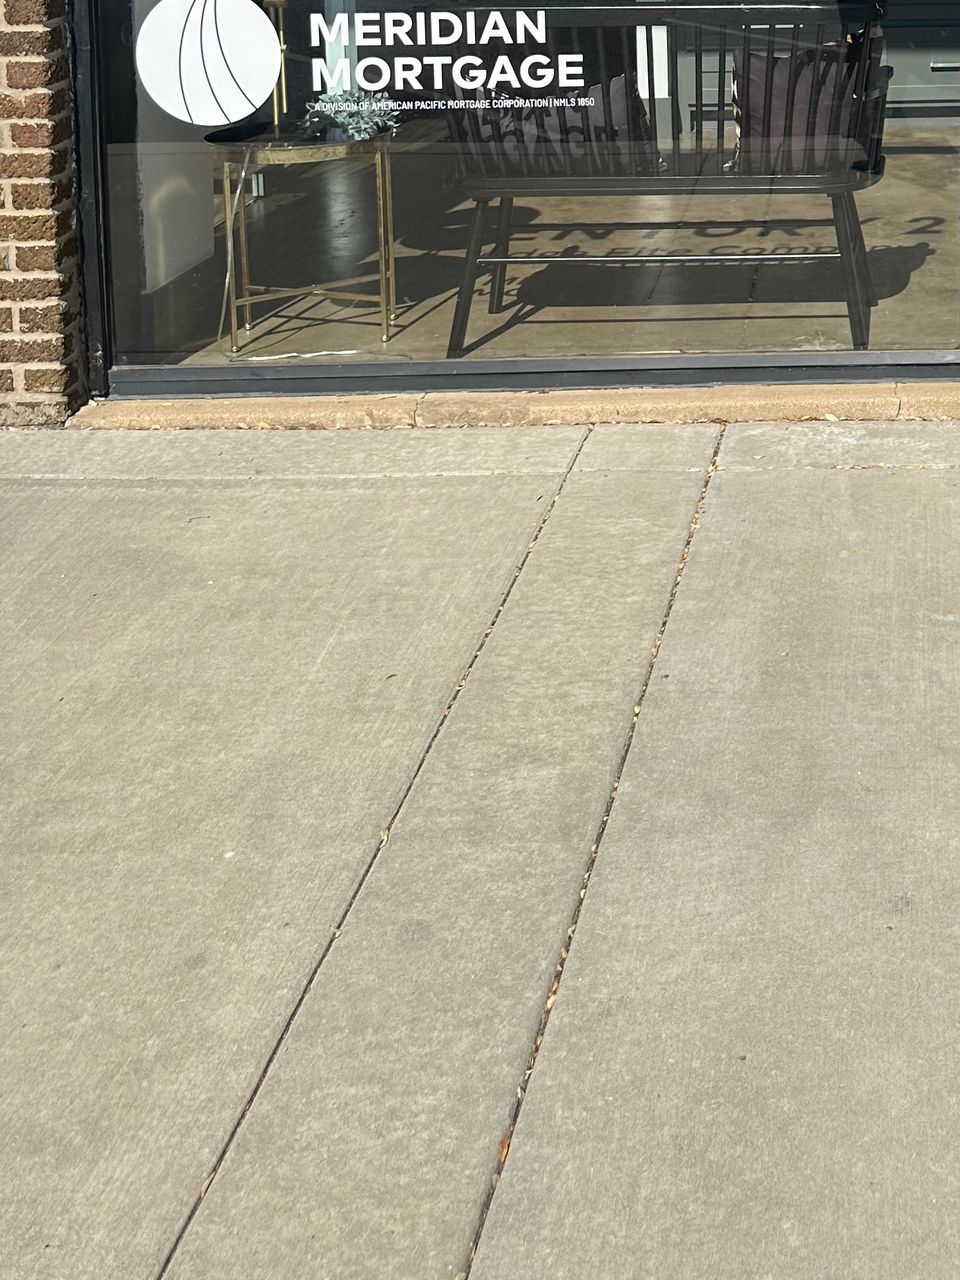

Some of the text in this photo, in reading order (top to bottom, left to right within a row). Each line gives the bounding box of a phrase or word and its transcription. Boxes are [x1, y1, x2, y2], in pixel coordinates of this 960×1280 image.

[310, 10, 547, 48] MERIDIAN
[311, 54, 585, 93] MORTGAGE
[321, 101, 358, 111] DIVISION
[358, 101, 370, 111] OF
[371, 101, 414, 110] AMERICAN
[414, 100, 447, 110] PACIFIC
[447, 99, 491, 109] MORTGAGE
[492, 98, 549, 108] CORPORATION
[553, 98, 576, 108] NMLS
